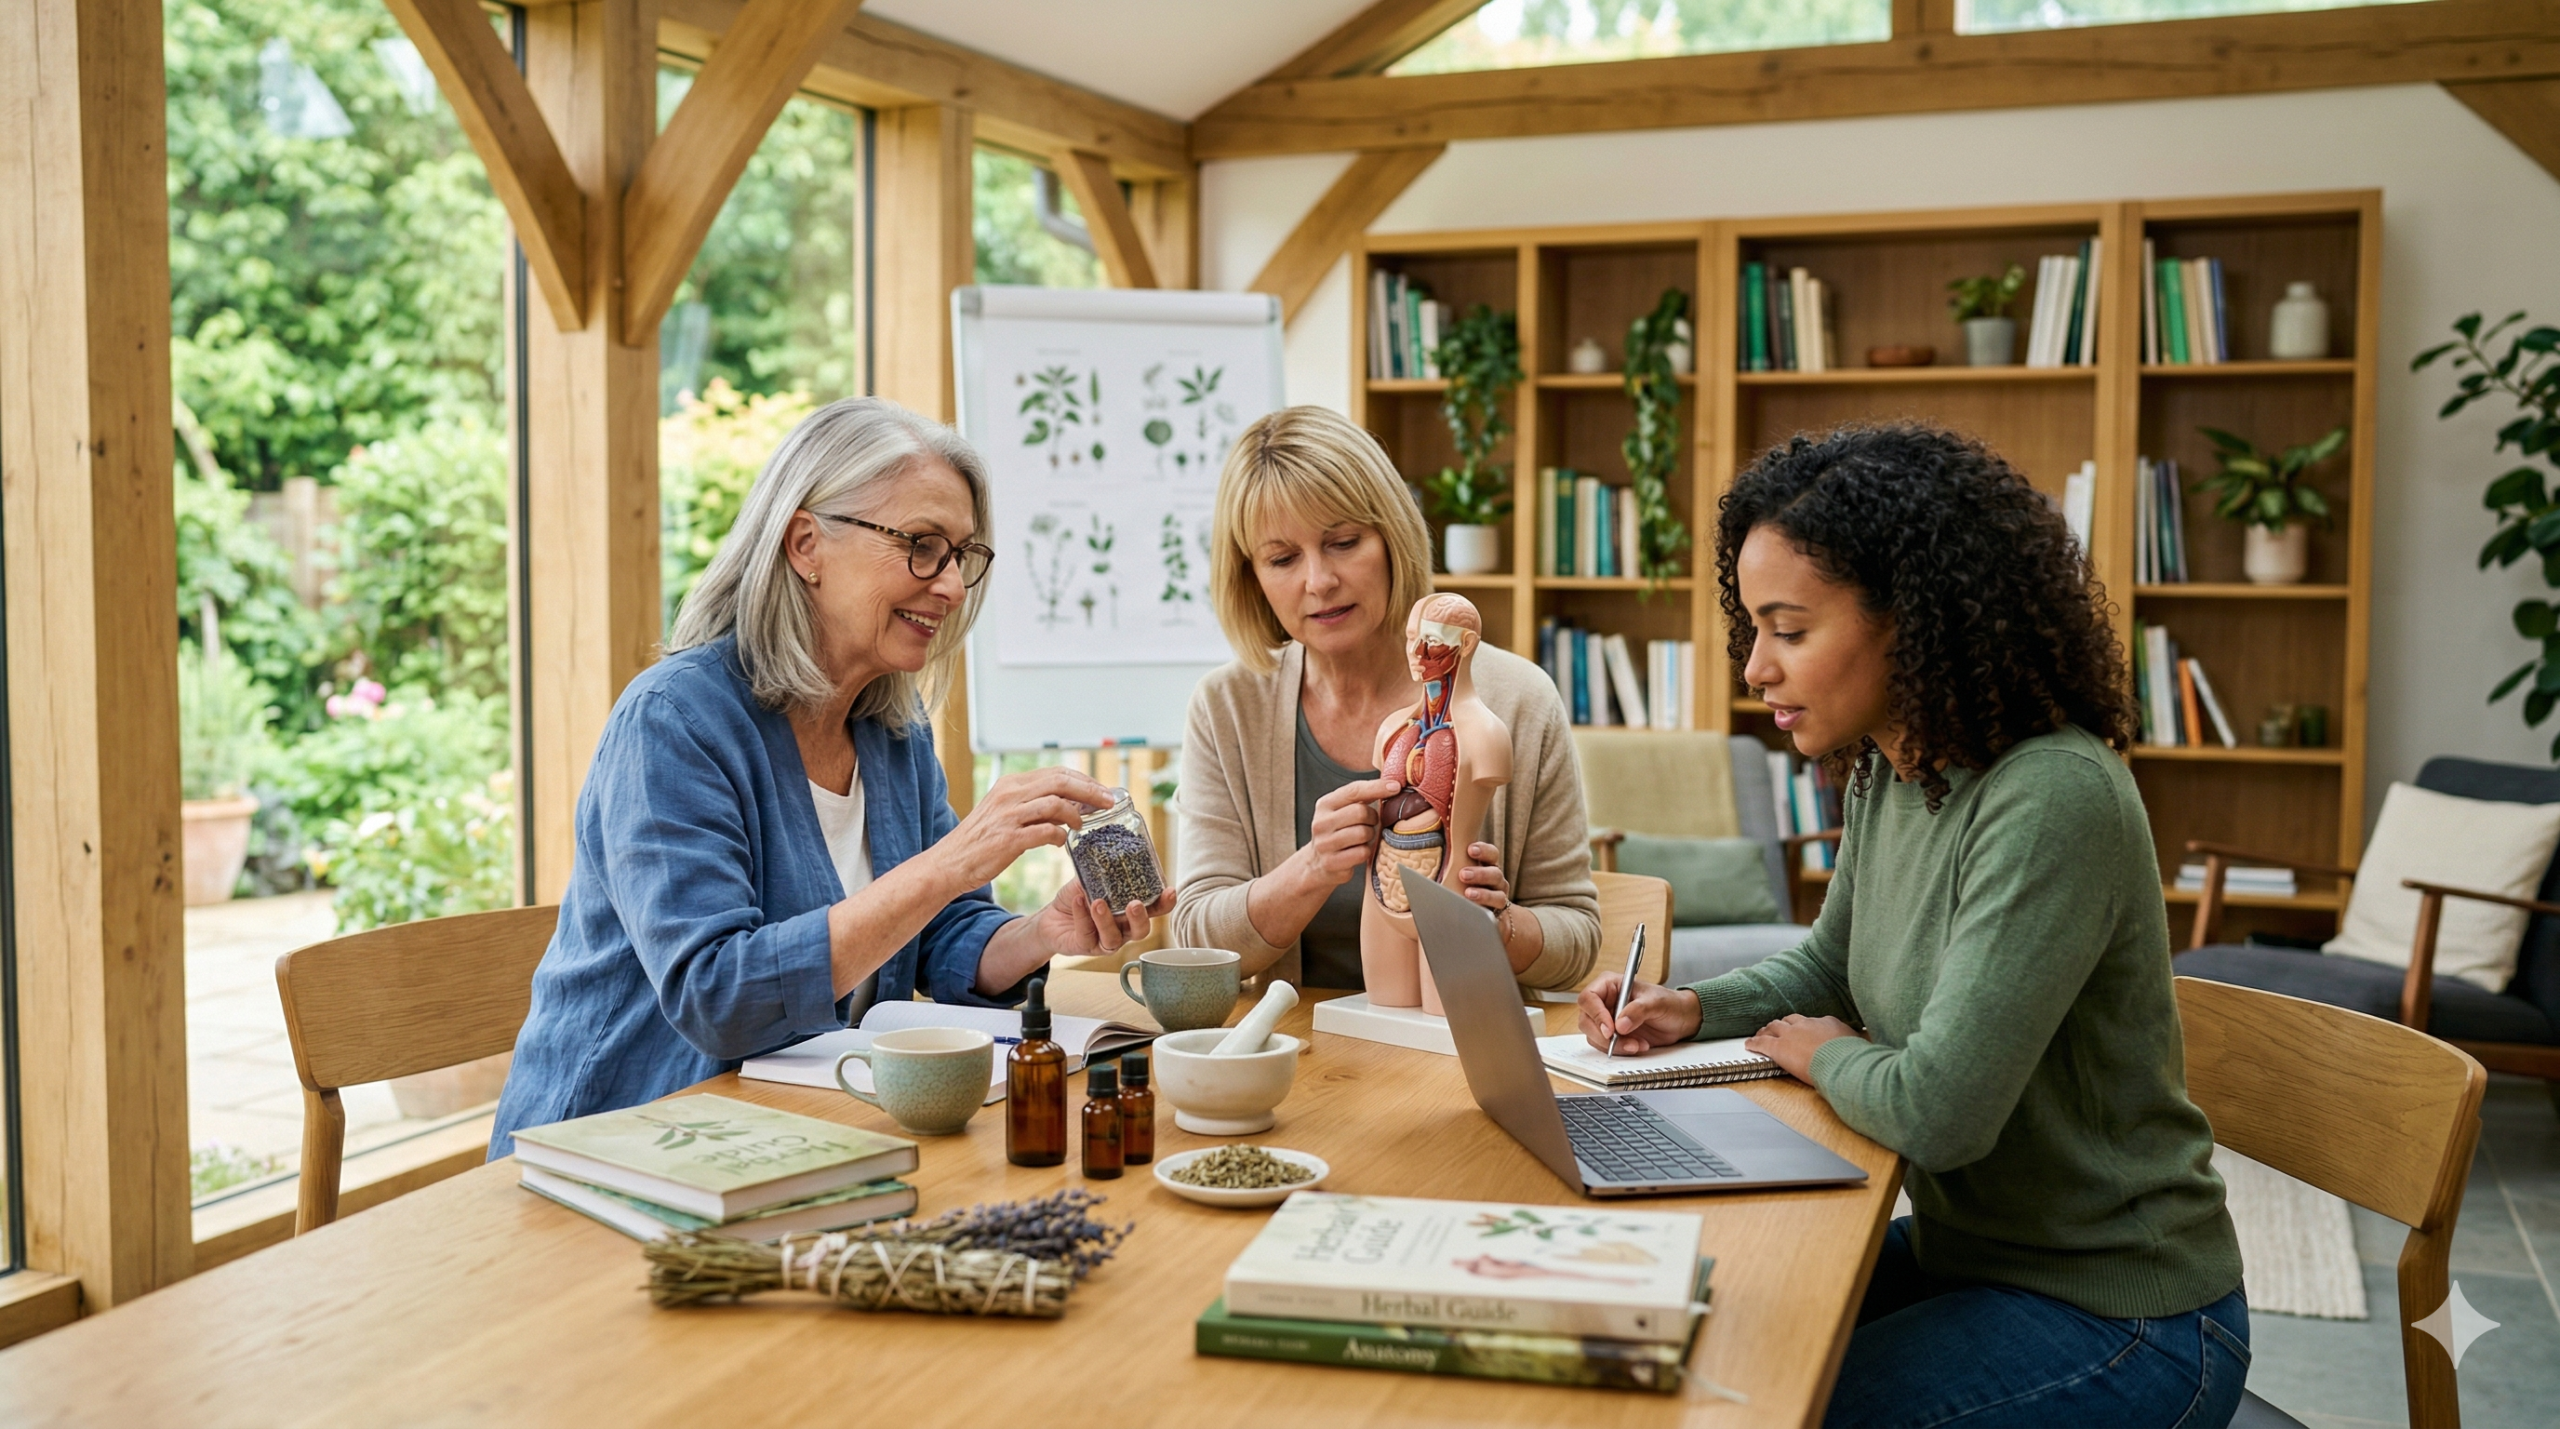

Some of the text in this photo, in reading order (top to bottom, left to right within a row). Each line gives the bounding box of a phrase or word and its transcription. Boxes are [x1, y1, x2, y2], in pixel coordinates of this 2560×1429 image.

[692, 1134, 808, 1163] Guide
[1341, 1218, 1403, 1264] Guide
[1360, 1293, 1440, 1317] Herbal
[1446, 1297, 1519, 1321] Guide
[1342, 1336, 1438, 1371] Anatomy
